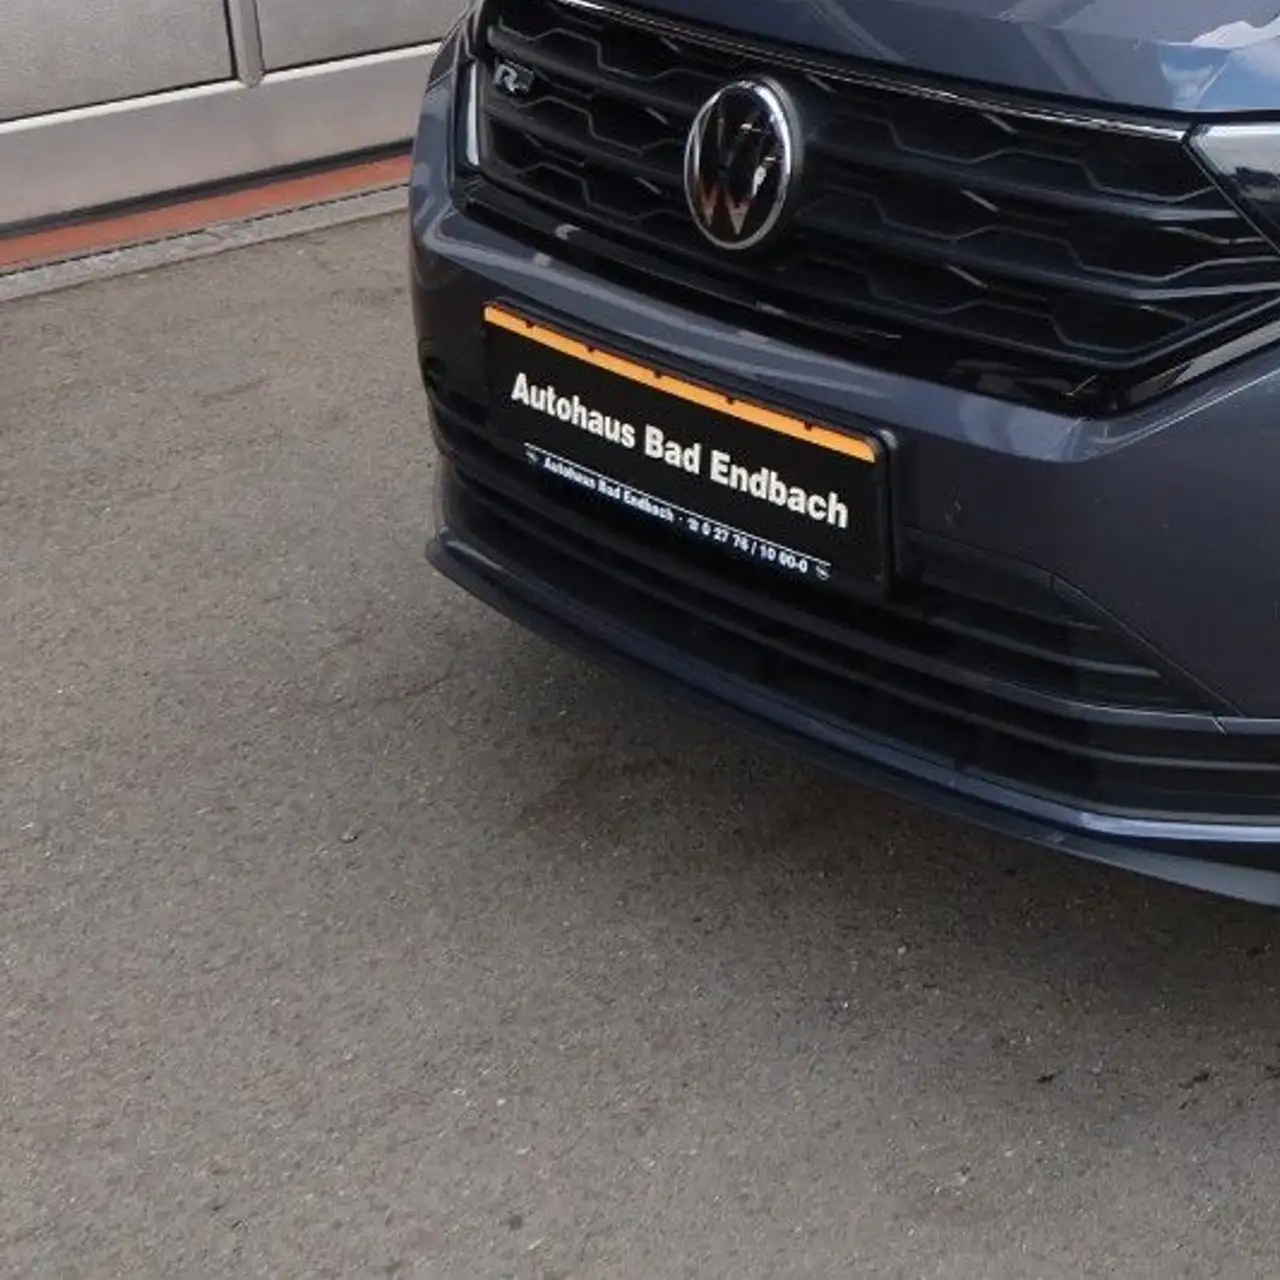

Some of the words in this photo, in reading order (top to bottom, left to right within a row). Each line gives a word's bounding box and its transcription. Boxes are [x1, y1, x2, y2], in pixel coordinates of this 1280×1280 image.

[511, 372, 635, 449] Autohaus
[644, 424, 701, 475] Bad
[710, 449, 848, 528] Endbach
